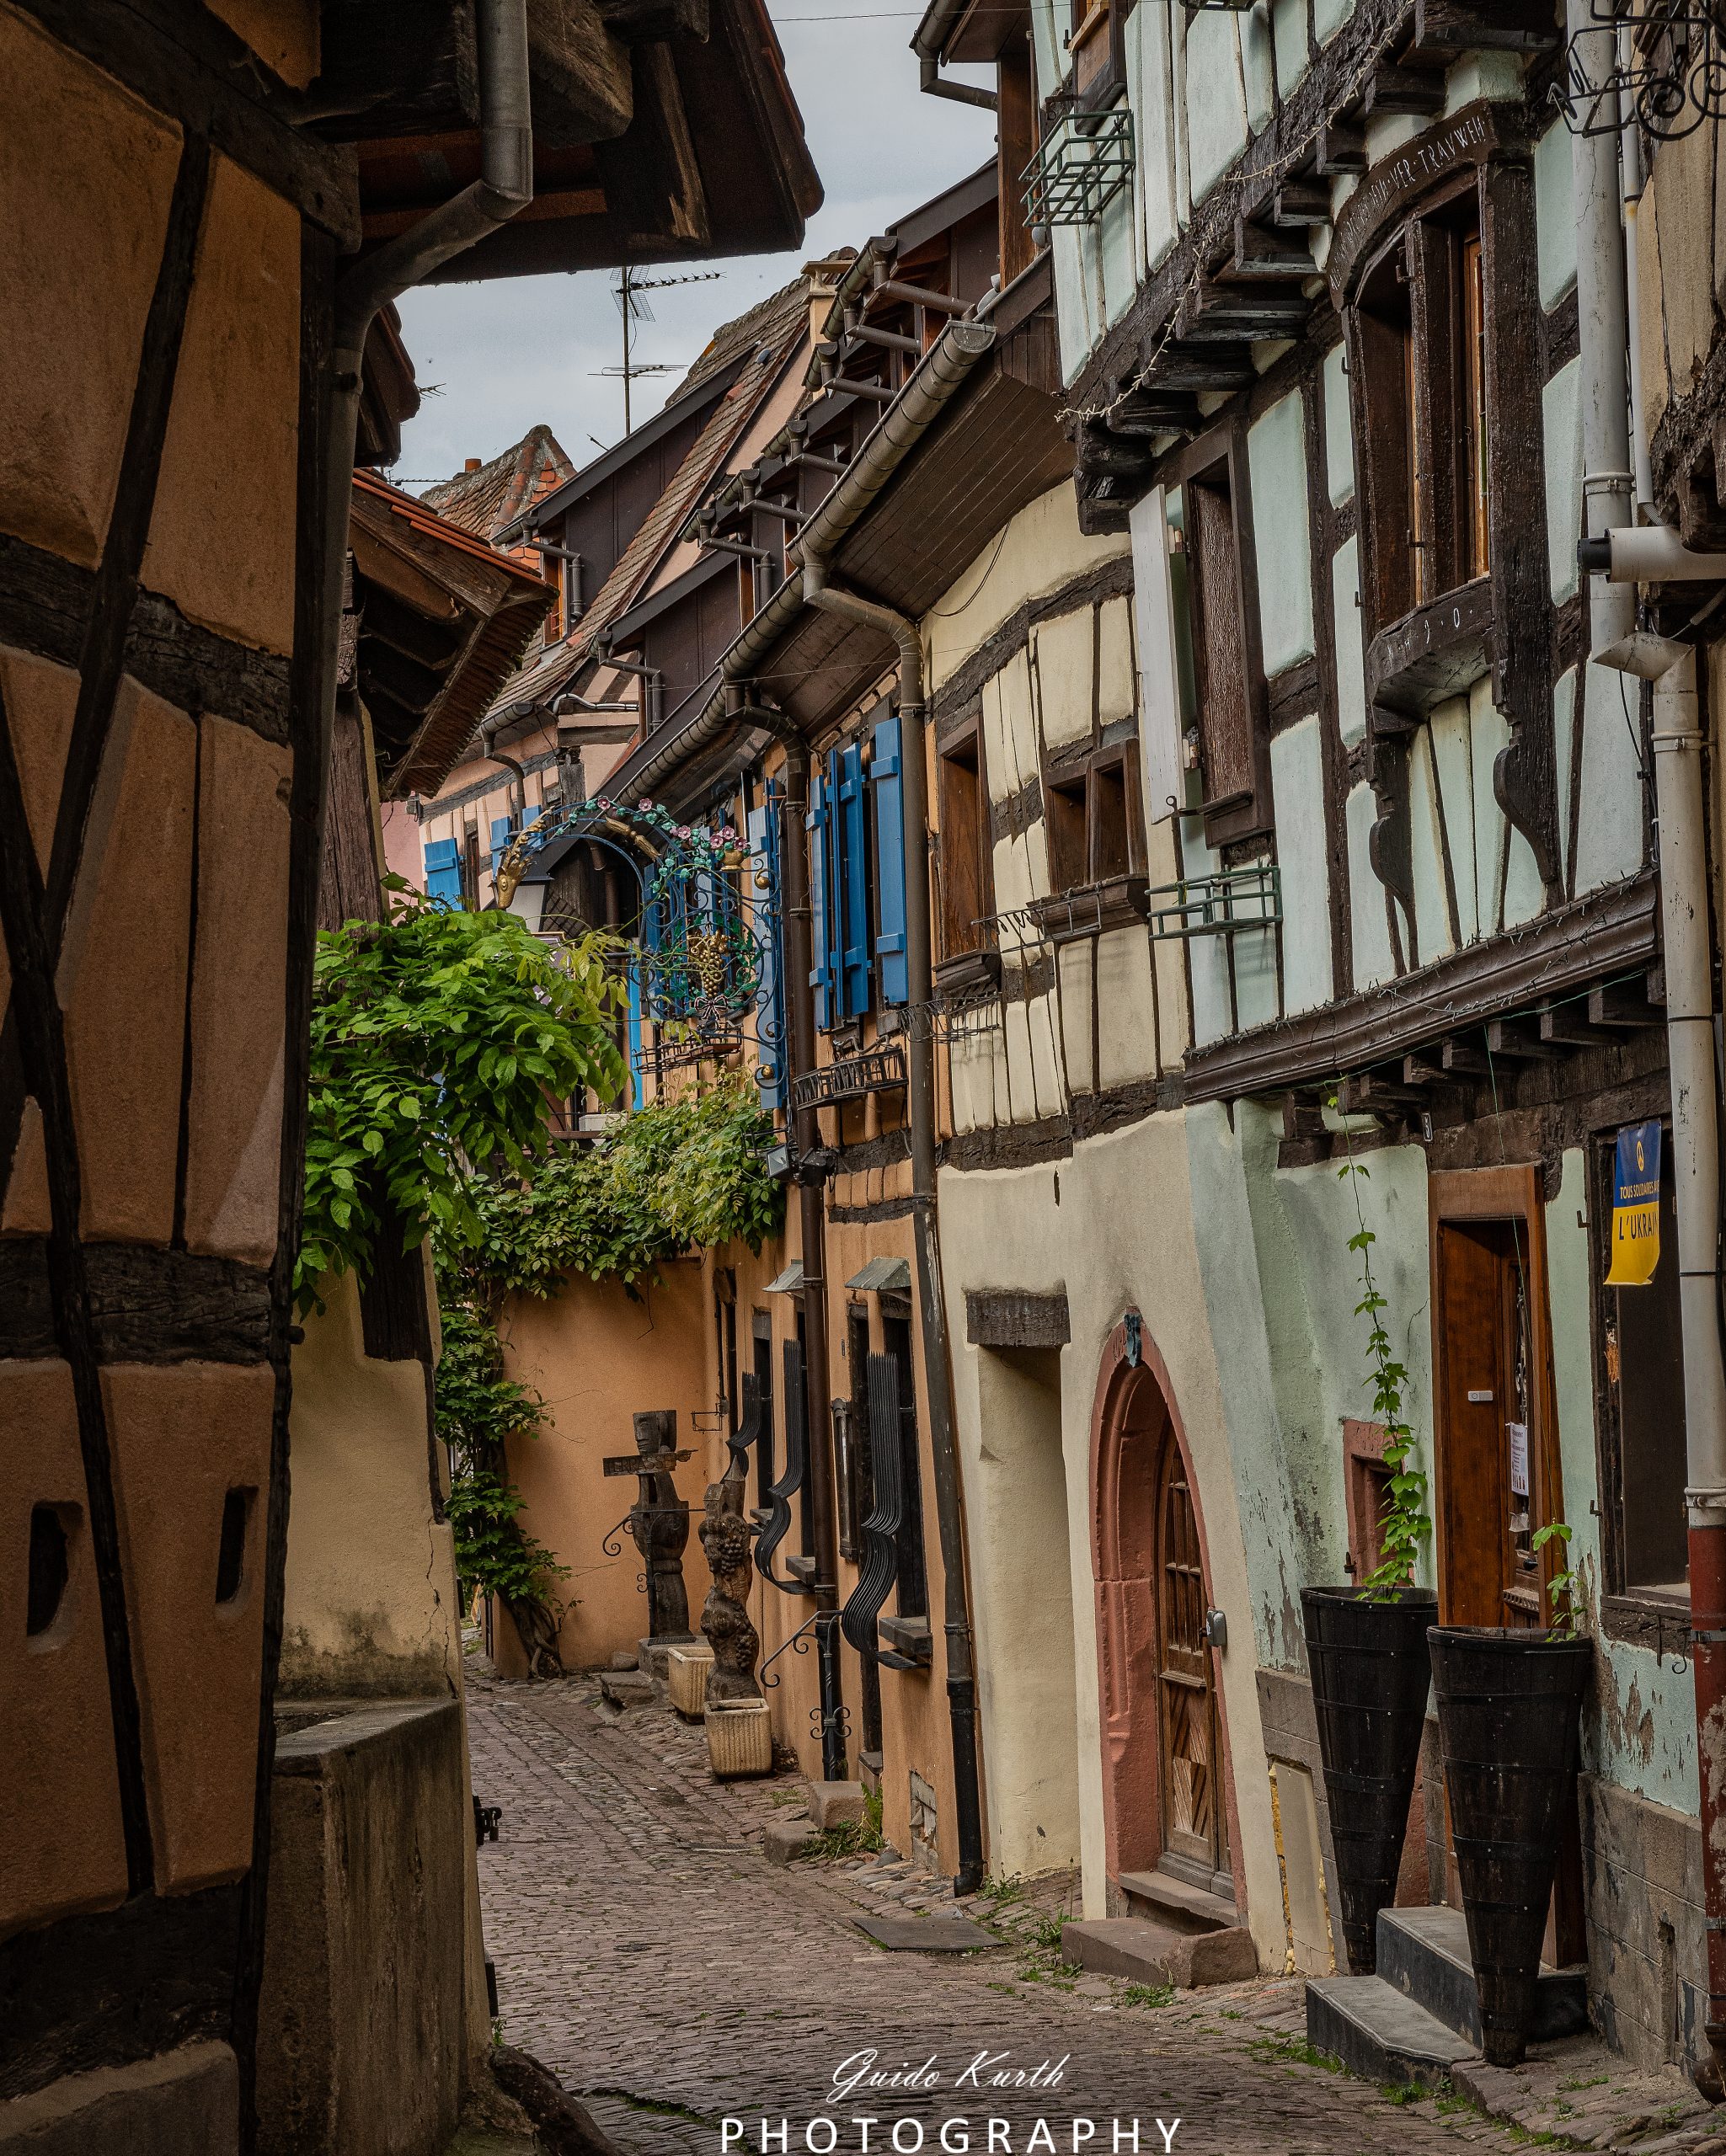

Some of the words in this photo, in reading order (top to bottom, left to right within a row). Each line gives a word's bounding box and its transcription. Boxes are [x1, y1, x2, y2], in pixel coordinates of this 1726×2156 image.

[1619, 1184, 1633, 1200] TOUS
[1633, 1181, 1654, 1198] SOLIDAIRES
[603, 1453, 676, 1474] TERRASSE
